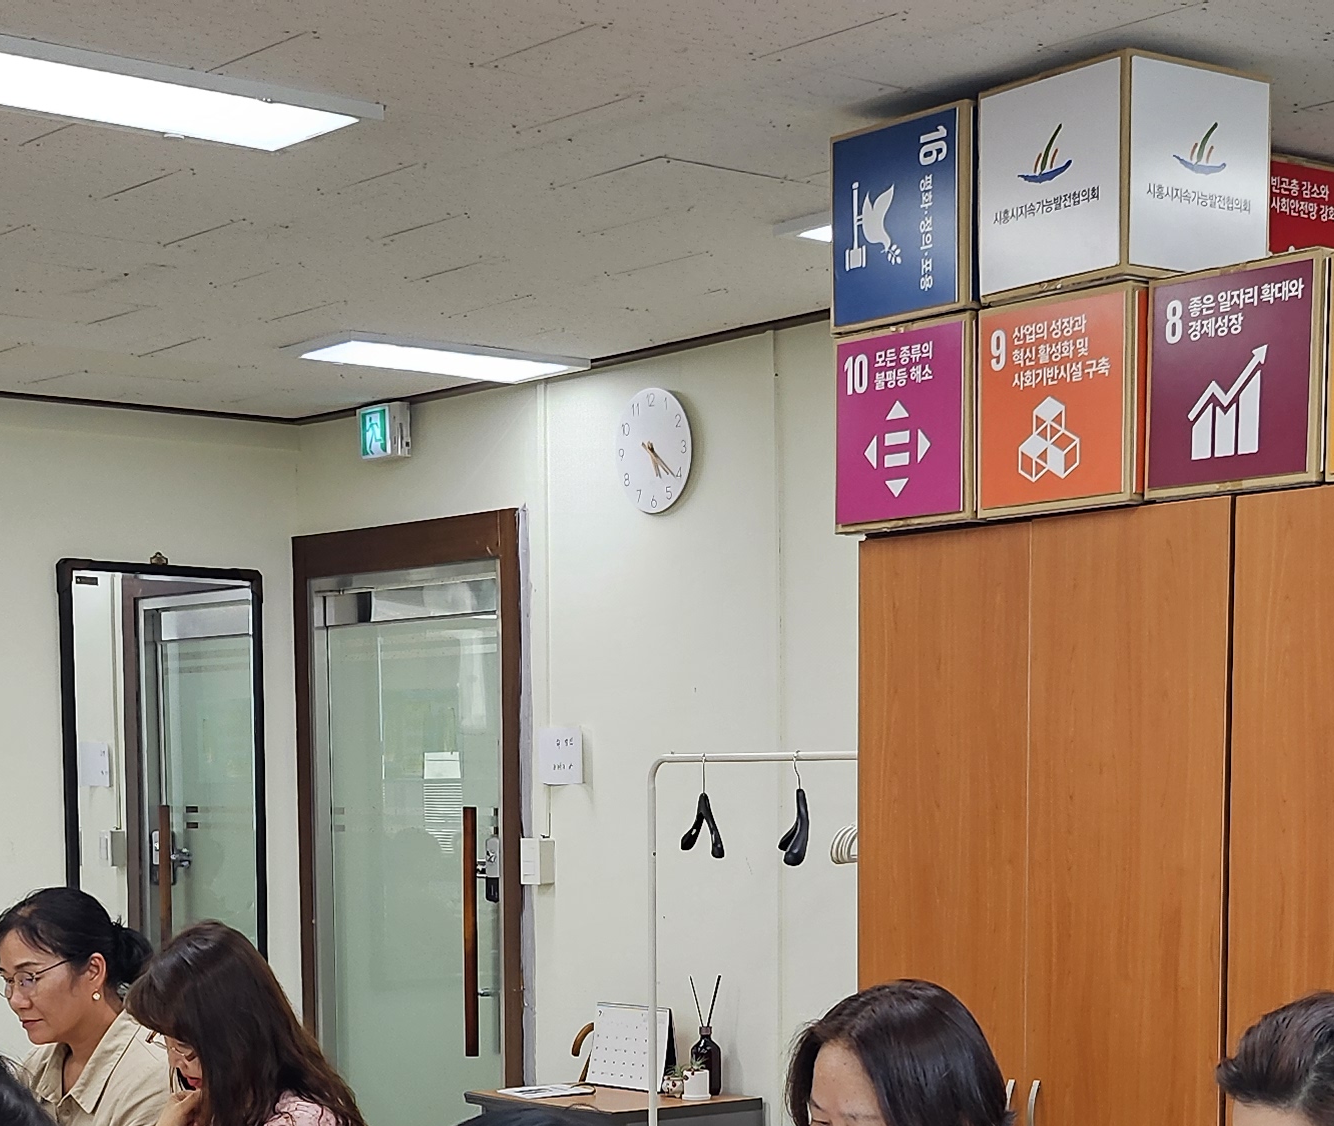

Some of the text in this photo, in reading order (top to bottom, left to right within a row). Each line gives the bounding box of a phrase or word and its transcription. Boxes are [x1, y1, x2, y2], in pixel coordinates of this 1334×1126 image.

[918, 125, 948, 166] 16
[1146, 182, 1252, 214] 시흥시지속가능발전협의회
[1270, 175, 1330, 201] 빈곤층 감소와
[992, 185, 1101, 226] 시흥시지속가능발전협의회
[1270, 196, 1318, 221] 사회안전망
[1188, 276, 1305, 316] 좋은 일자리 확대와
[1012, 313, 1088, 345] 산업의 성장과
[1165, 299, 1182, 344] 8
[1188, 315, 1244, 342] 경제성장
[874, 340, 933, 367] 모든 종류의
[990, 329, 1007, 372] 9
[1012, 337, 1089, 367] 혁신 활성화 및
[844, 352, 869, 395] 10
[874, 364, 934, 392] 불평등 해소
[1012, 356, 1111, 392] 사회기반시설 구축
[632, 403, 640, 416] 11
[647, 393, 655, 407] 12
[622, 422, 630, 436] 10
[675, 413, 682, 428] 2
[618, 448, 625, 461] 9
[680, 439, 687, 454] 3
[623, 472, 630, 487] 8
[675, 466, 682, 478] 4
[636, 488, 642, 503] 7
[650, 495, 657, 508] 6
[665, 485, 672, 500] 5
